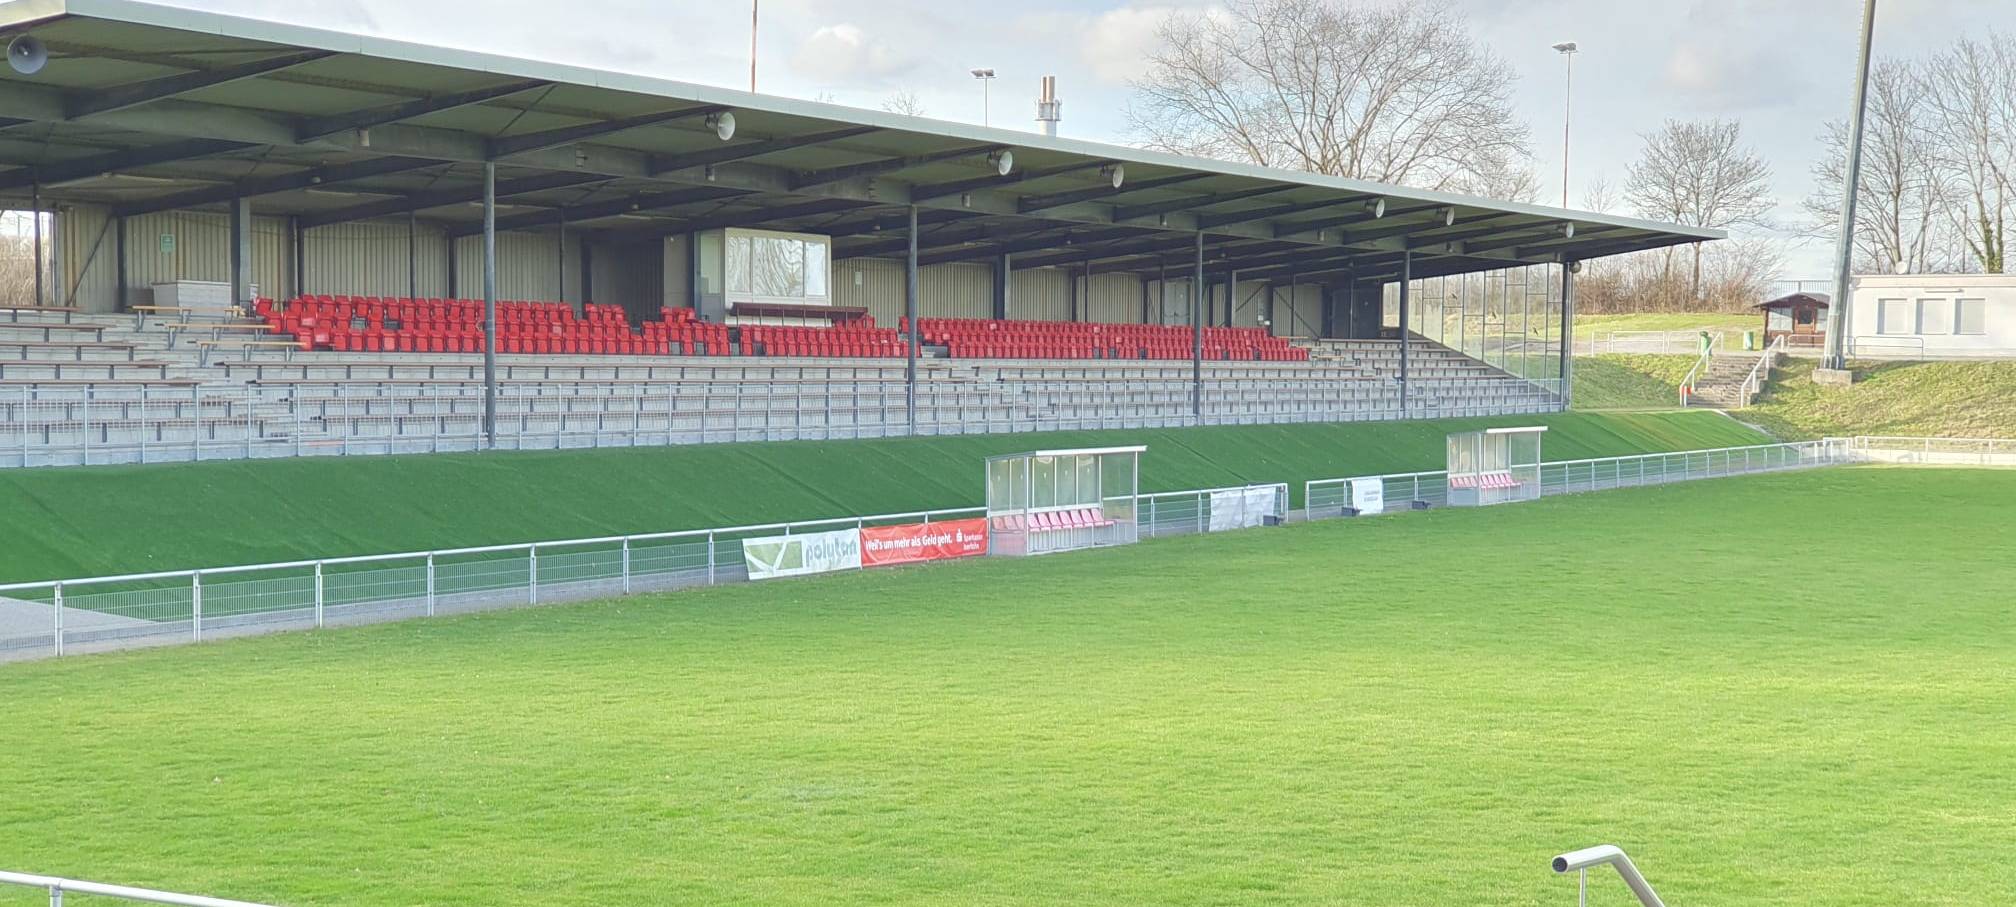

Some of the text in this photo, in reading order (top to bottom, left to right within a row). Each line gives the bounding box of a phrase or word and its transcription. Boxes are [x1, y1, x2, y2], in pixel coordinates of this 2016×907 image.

[865, 533, 953, 551] Weil's um mehr als Geld geht.
